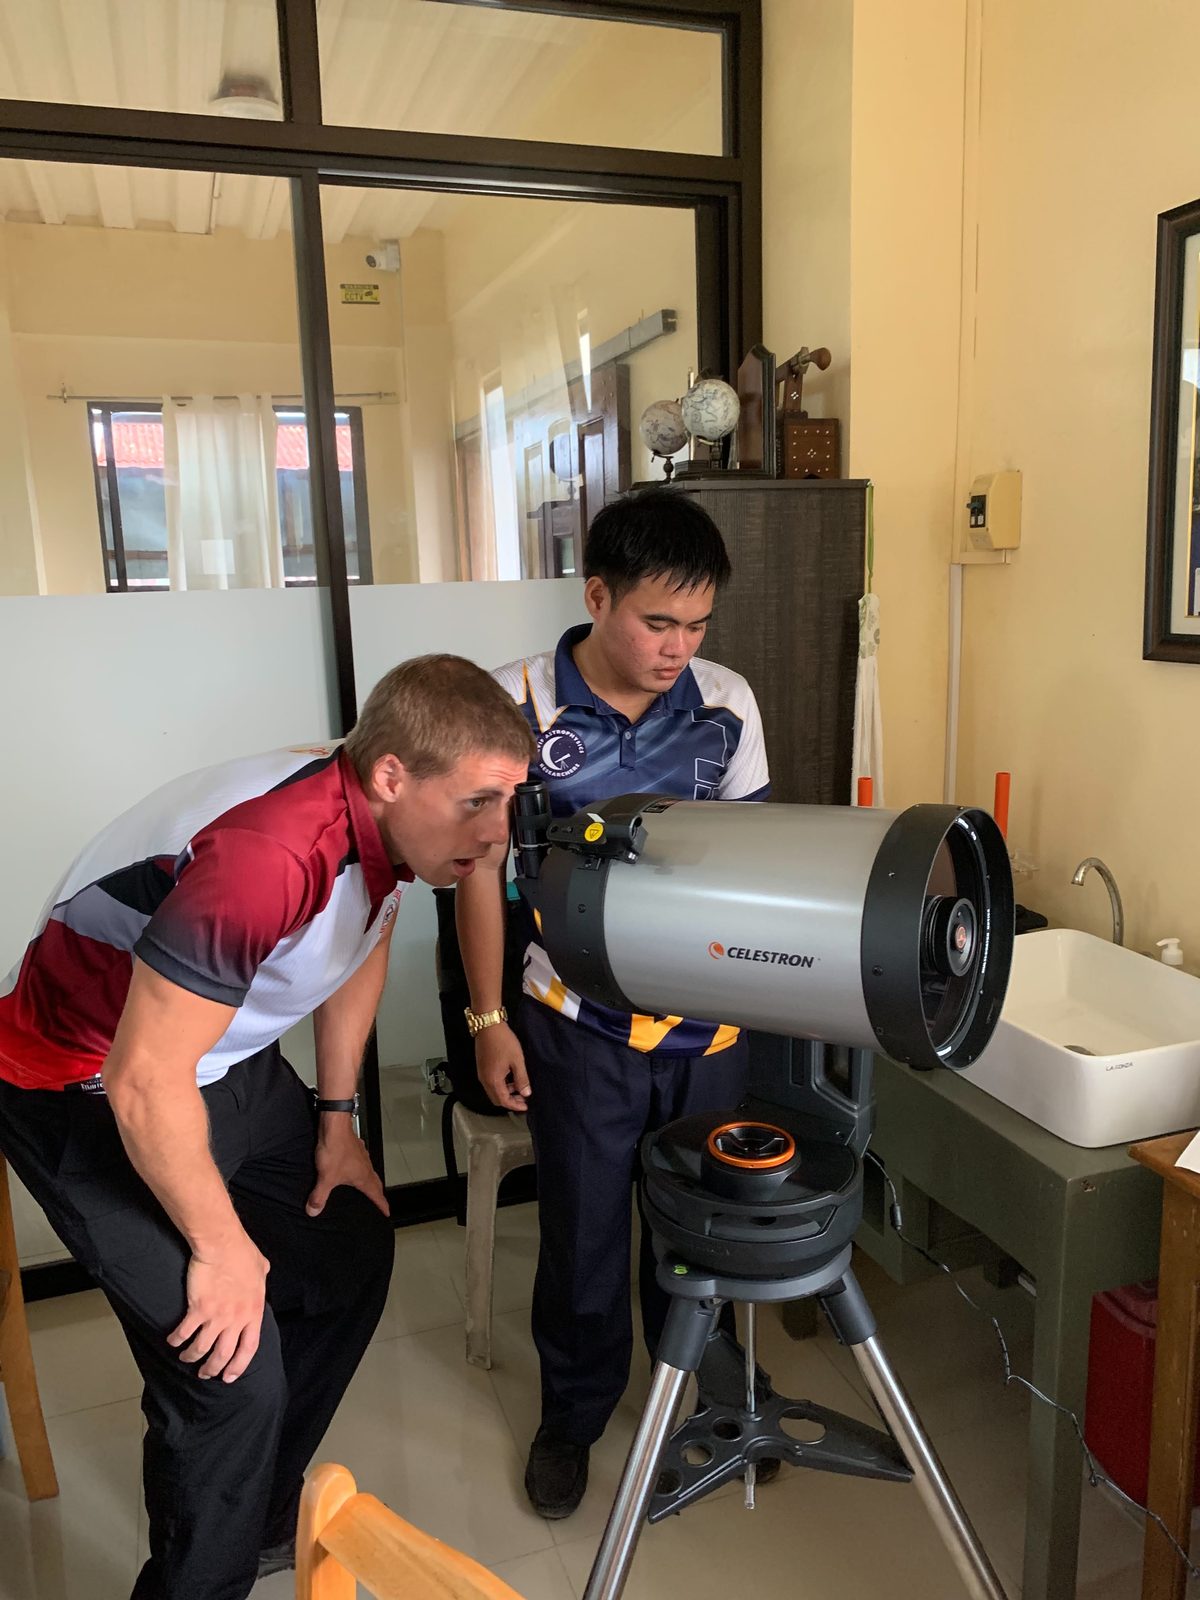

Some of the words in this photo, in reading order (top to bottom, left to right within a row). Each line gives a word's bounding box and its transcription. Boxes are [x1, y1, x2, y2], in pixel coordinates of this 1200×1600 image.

[345, 293, 364, 301] CCTV
[539, 763, 581, 777] RESEARCHERS
[727, 946, 815, 968] CELESTRON
